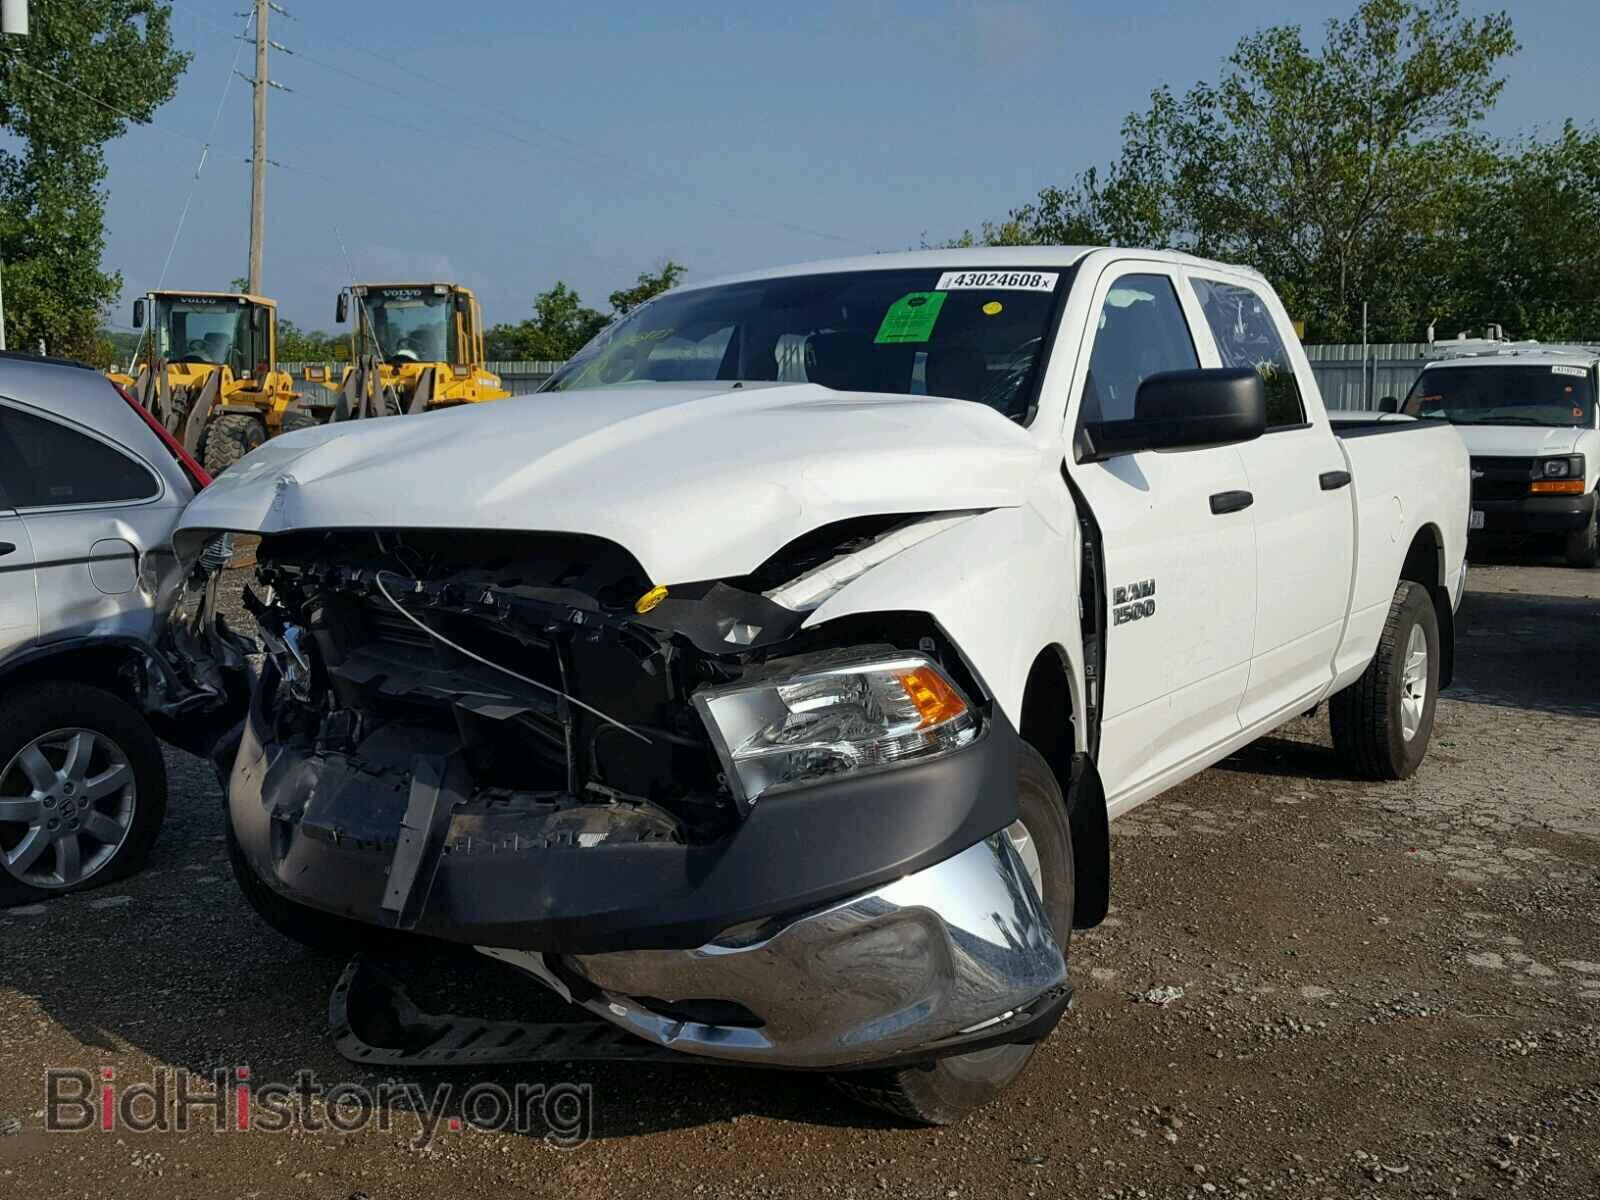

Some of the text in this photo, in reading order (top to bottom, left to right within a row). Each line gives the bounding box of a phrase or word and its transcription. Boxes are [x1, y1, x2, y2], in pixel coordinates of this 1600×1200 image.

[383, 289, 422, 297] VOLVO
[1113, 579, 1156, 606] RAM
[1113, 599, 1156, 626] 1500
